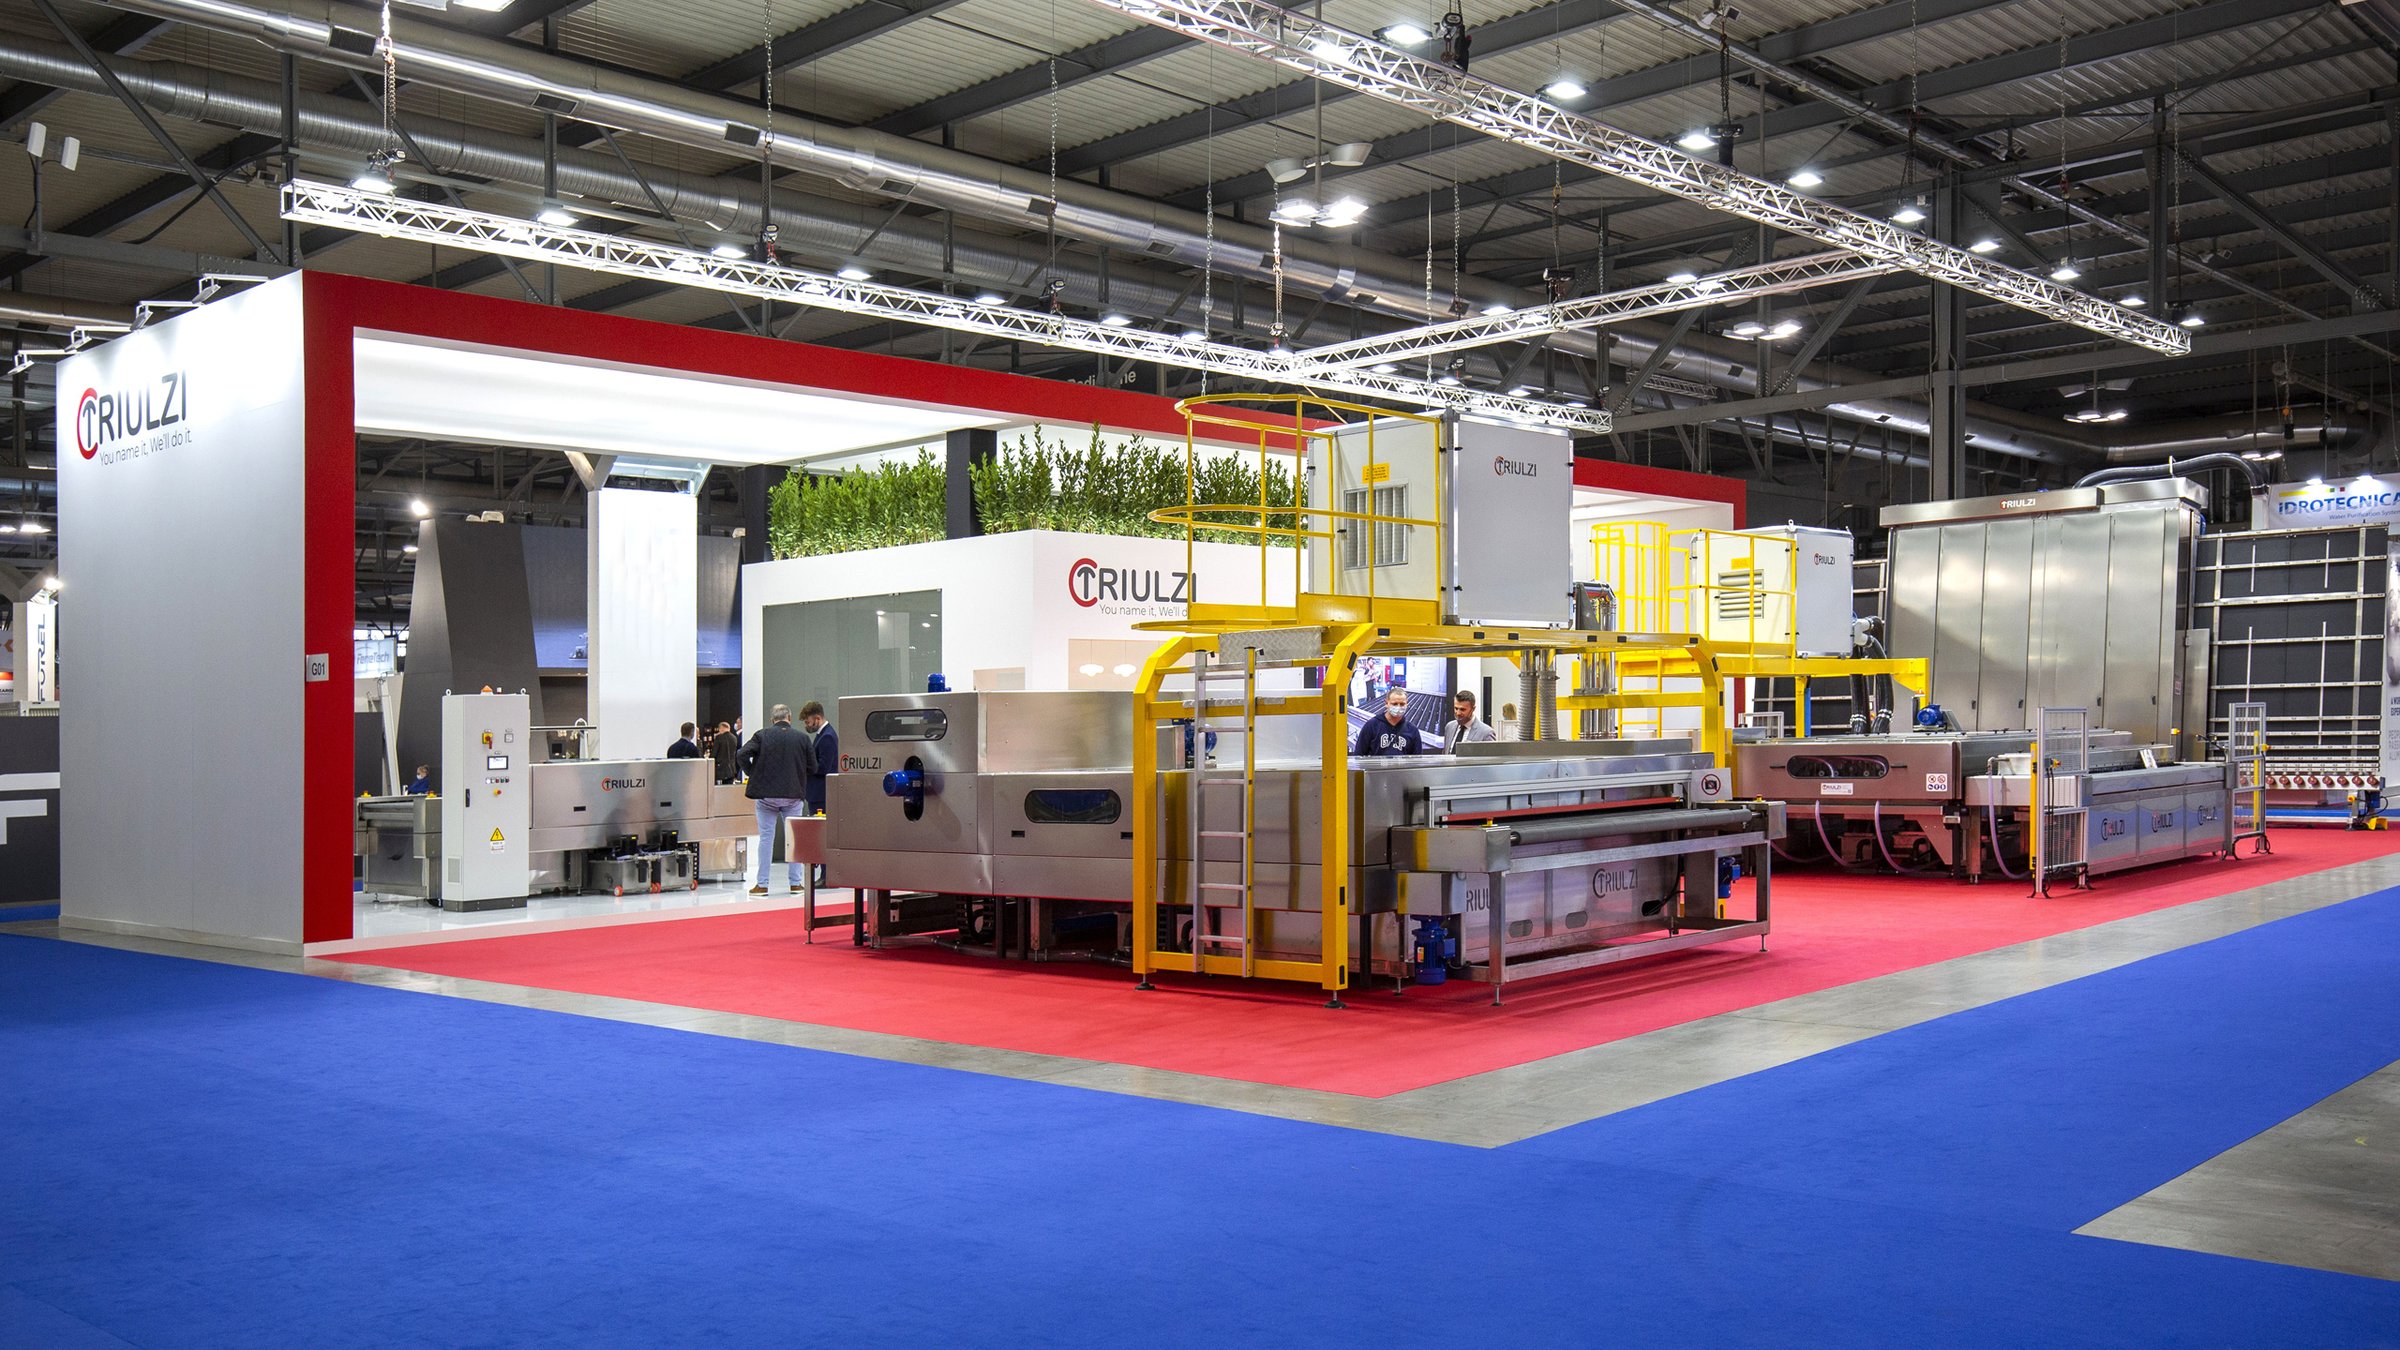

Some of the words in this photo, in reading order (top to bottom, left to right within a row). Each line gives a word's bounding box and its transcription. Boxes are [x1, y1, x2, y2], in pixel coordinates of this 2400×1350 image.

[99, 451, 114, 466] You
[115, 446, 140, 462] name
[141, 440, 149, 456] it,
[171, 430, 184, 447] do
[1099, 604, 1117, 615] You
[1119, 606, 1147, 616] name
[1148, 605, 1157, 618] it,
[311, 662, 325, 676] G01
[1380, 733, 1407, 751] GAP
[1466, 888, 1490, 912] RIUL
